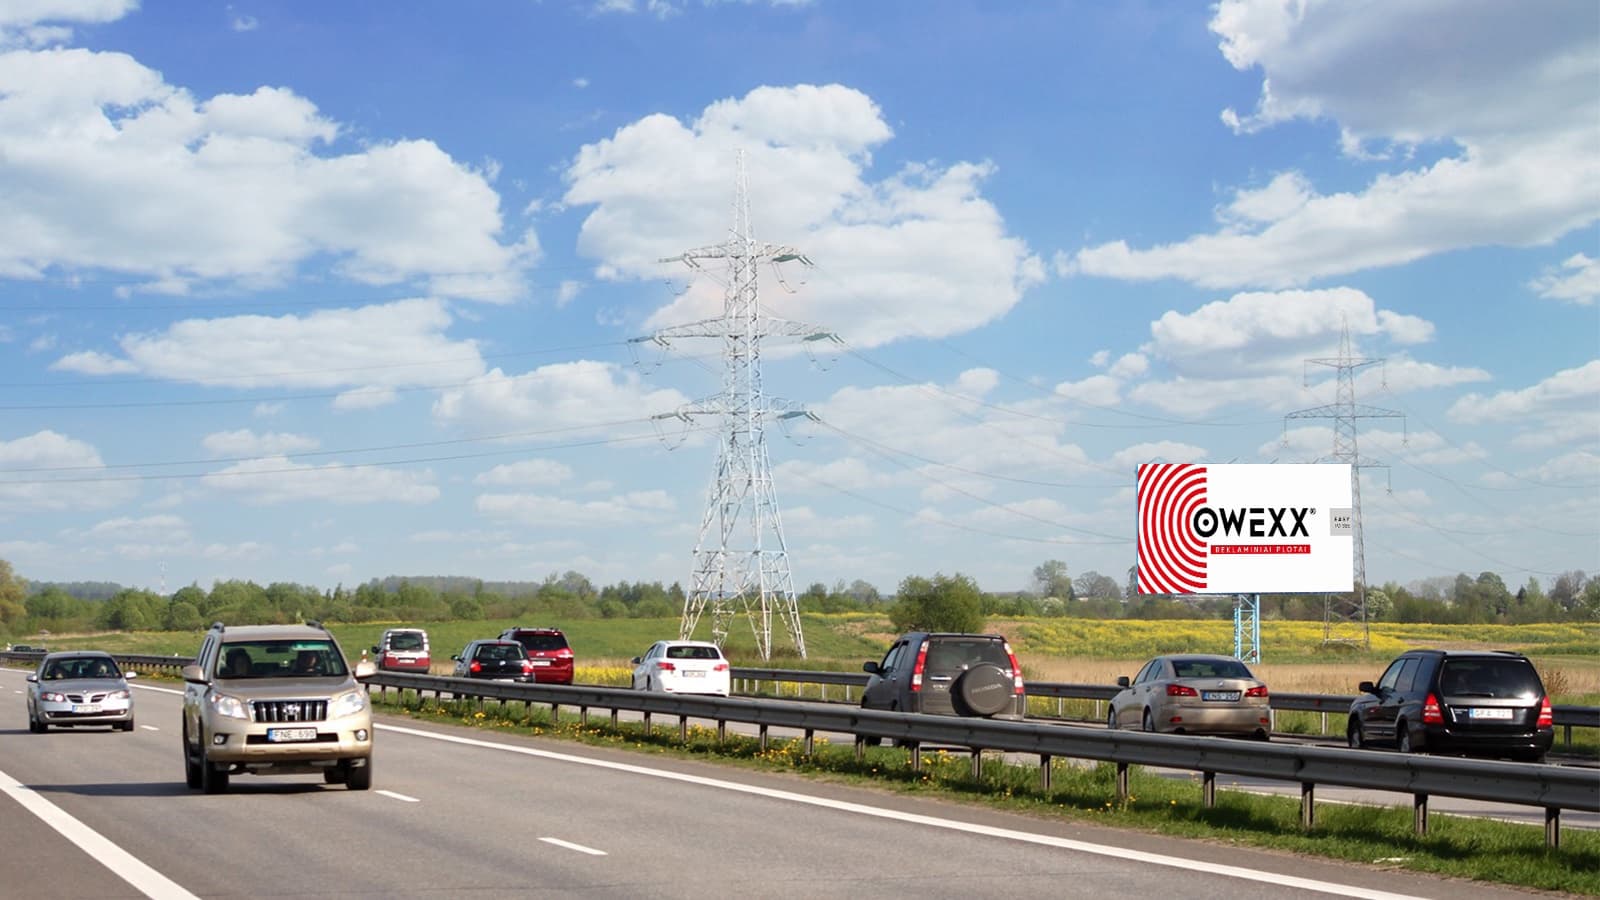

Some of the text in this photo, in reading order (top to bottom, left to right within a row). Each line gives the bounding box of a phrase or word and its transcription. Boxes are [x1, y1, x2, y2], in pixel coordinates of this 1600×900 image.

[1193, 507, 1309, 538] OWEXX
[1215, 545, 1307, 553] REKLAMINIAI PLOTAI
